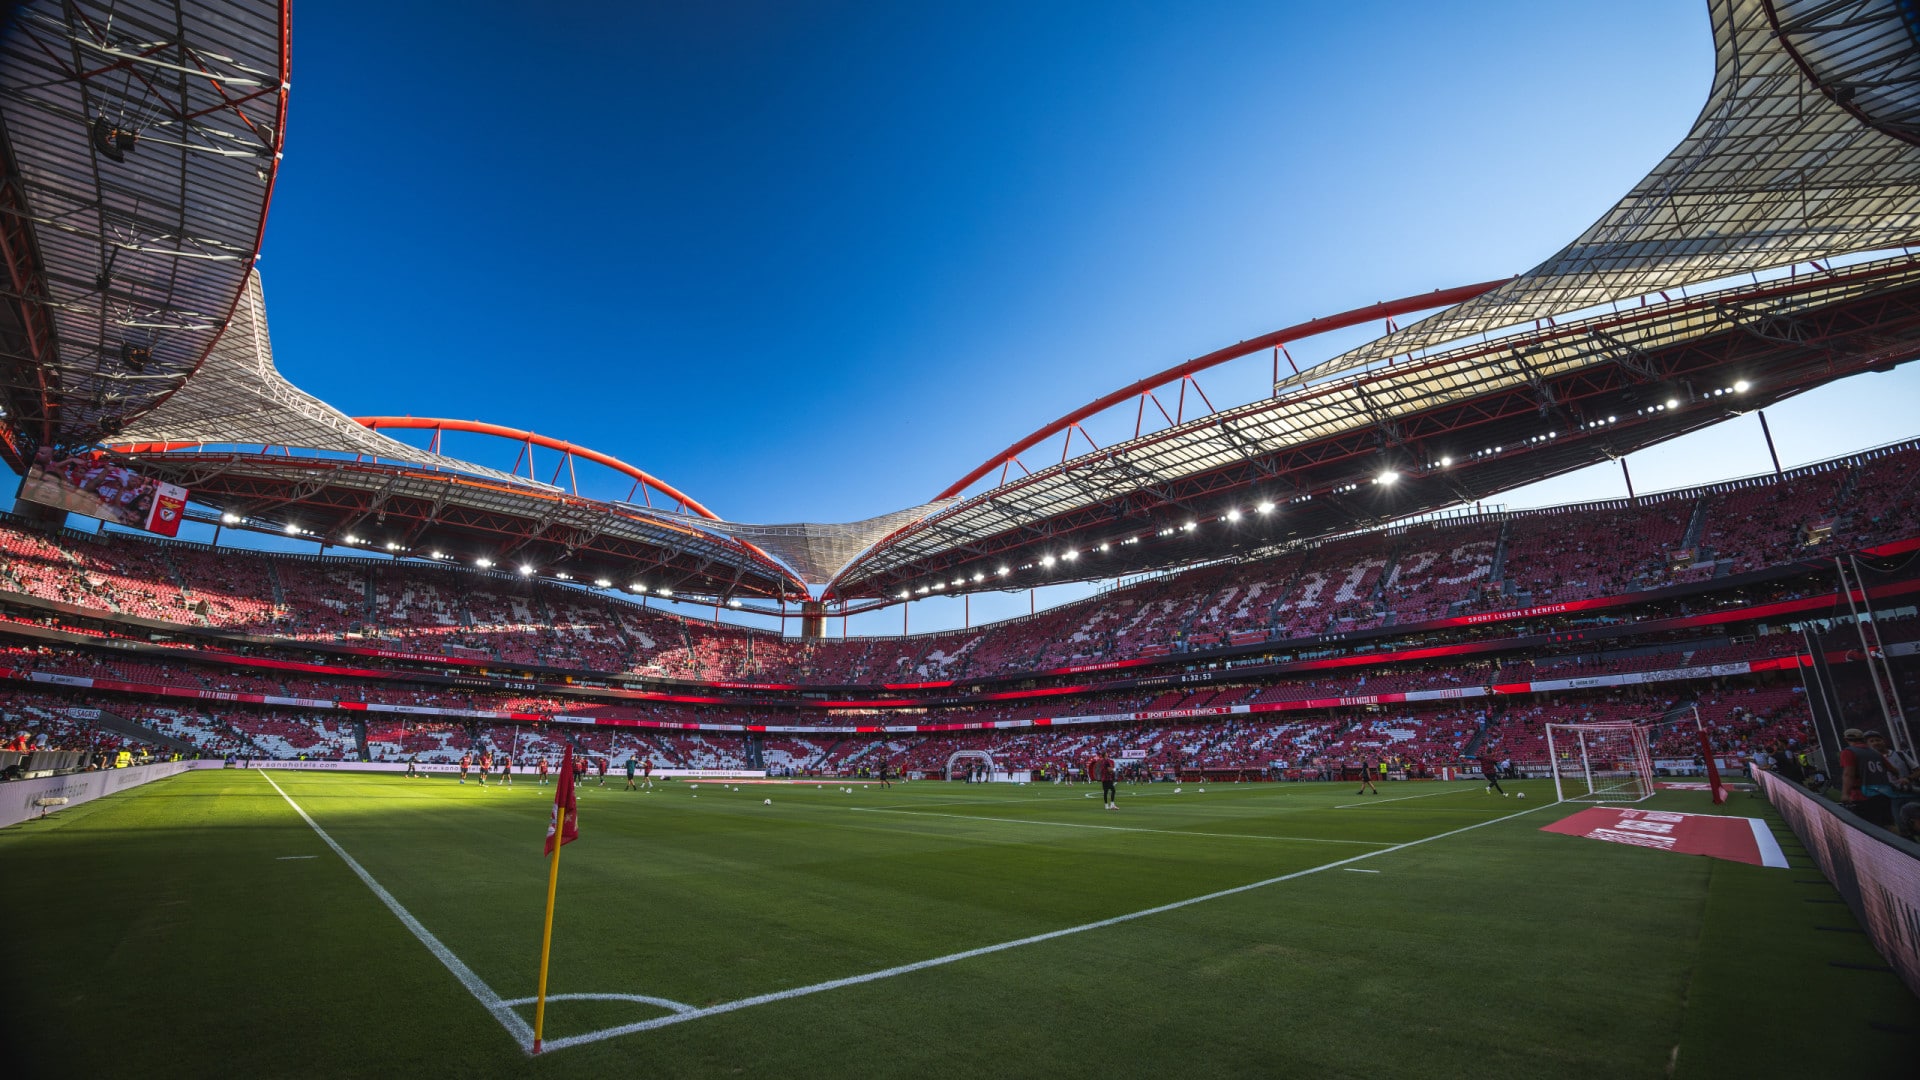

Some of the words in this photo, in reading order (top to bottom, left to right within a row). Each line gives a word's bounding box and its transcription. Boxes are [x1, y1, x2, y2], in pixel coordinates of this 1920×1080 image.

[1468, 615, 1491, 623] SPORT
[1494, 611, 1521, 620] LISBOA
[1532, 605, 1566, 614] BENFICA
[77, 708, 100, 718] SAGRES
[1147, 711, 1164, 719] SPORT
[1165, 709, 1187, 718] LISBOA
[1192, 707, 1217, 716] BENFICA
